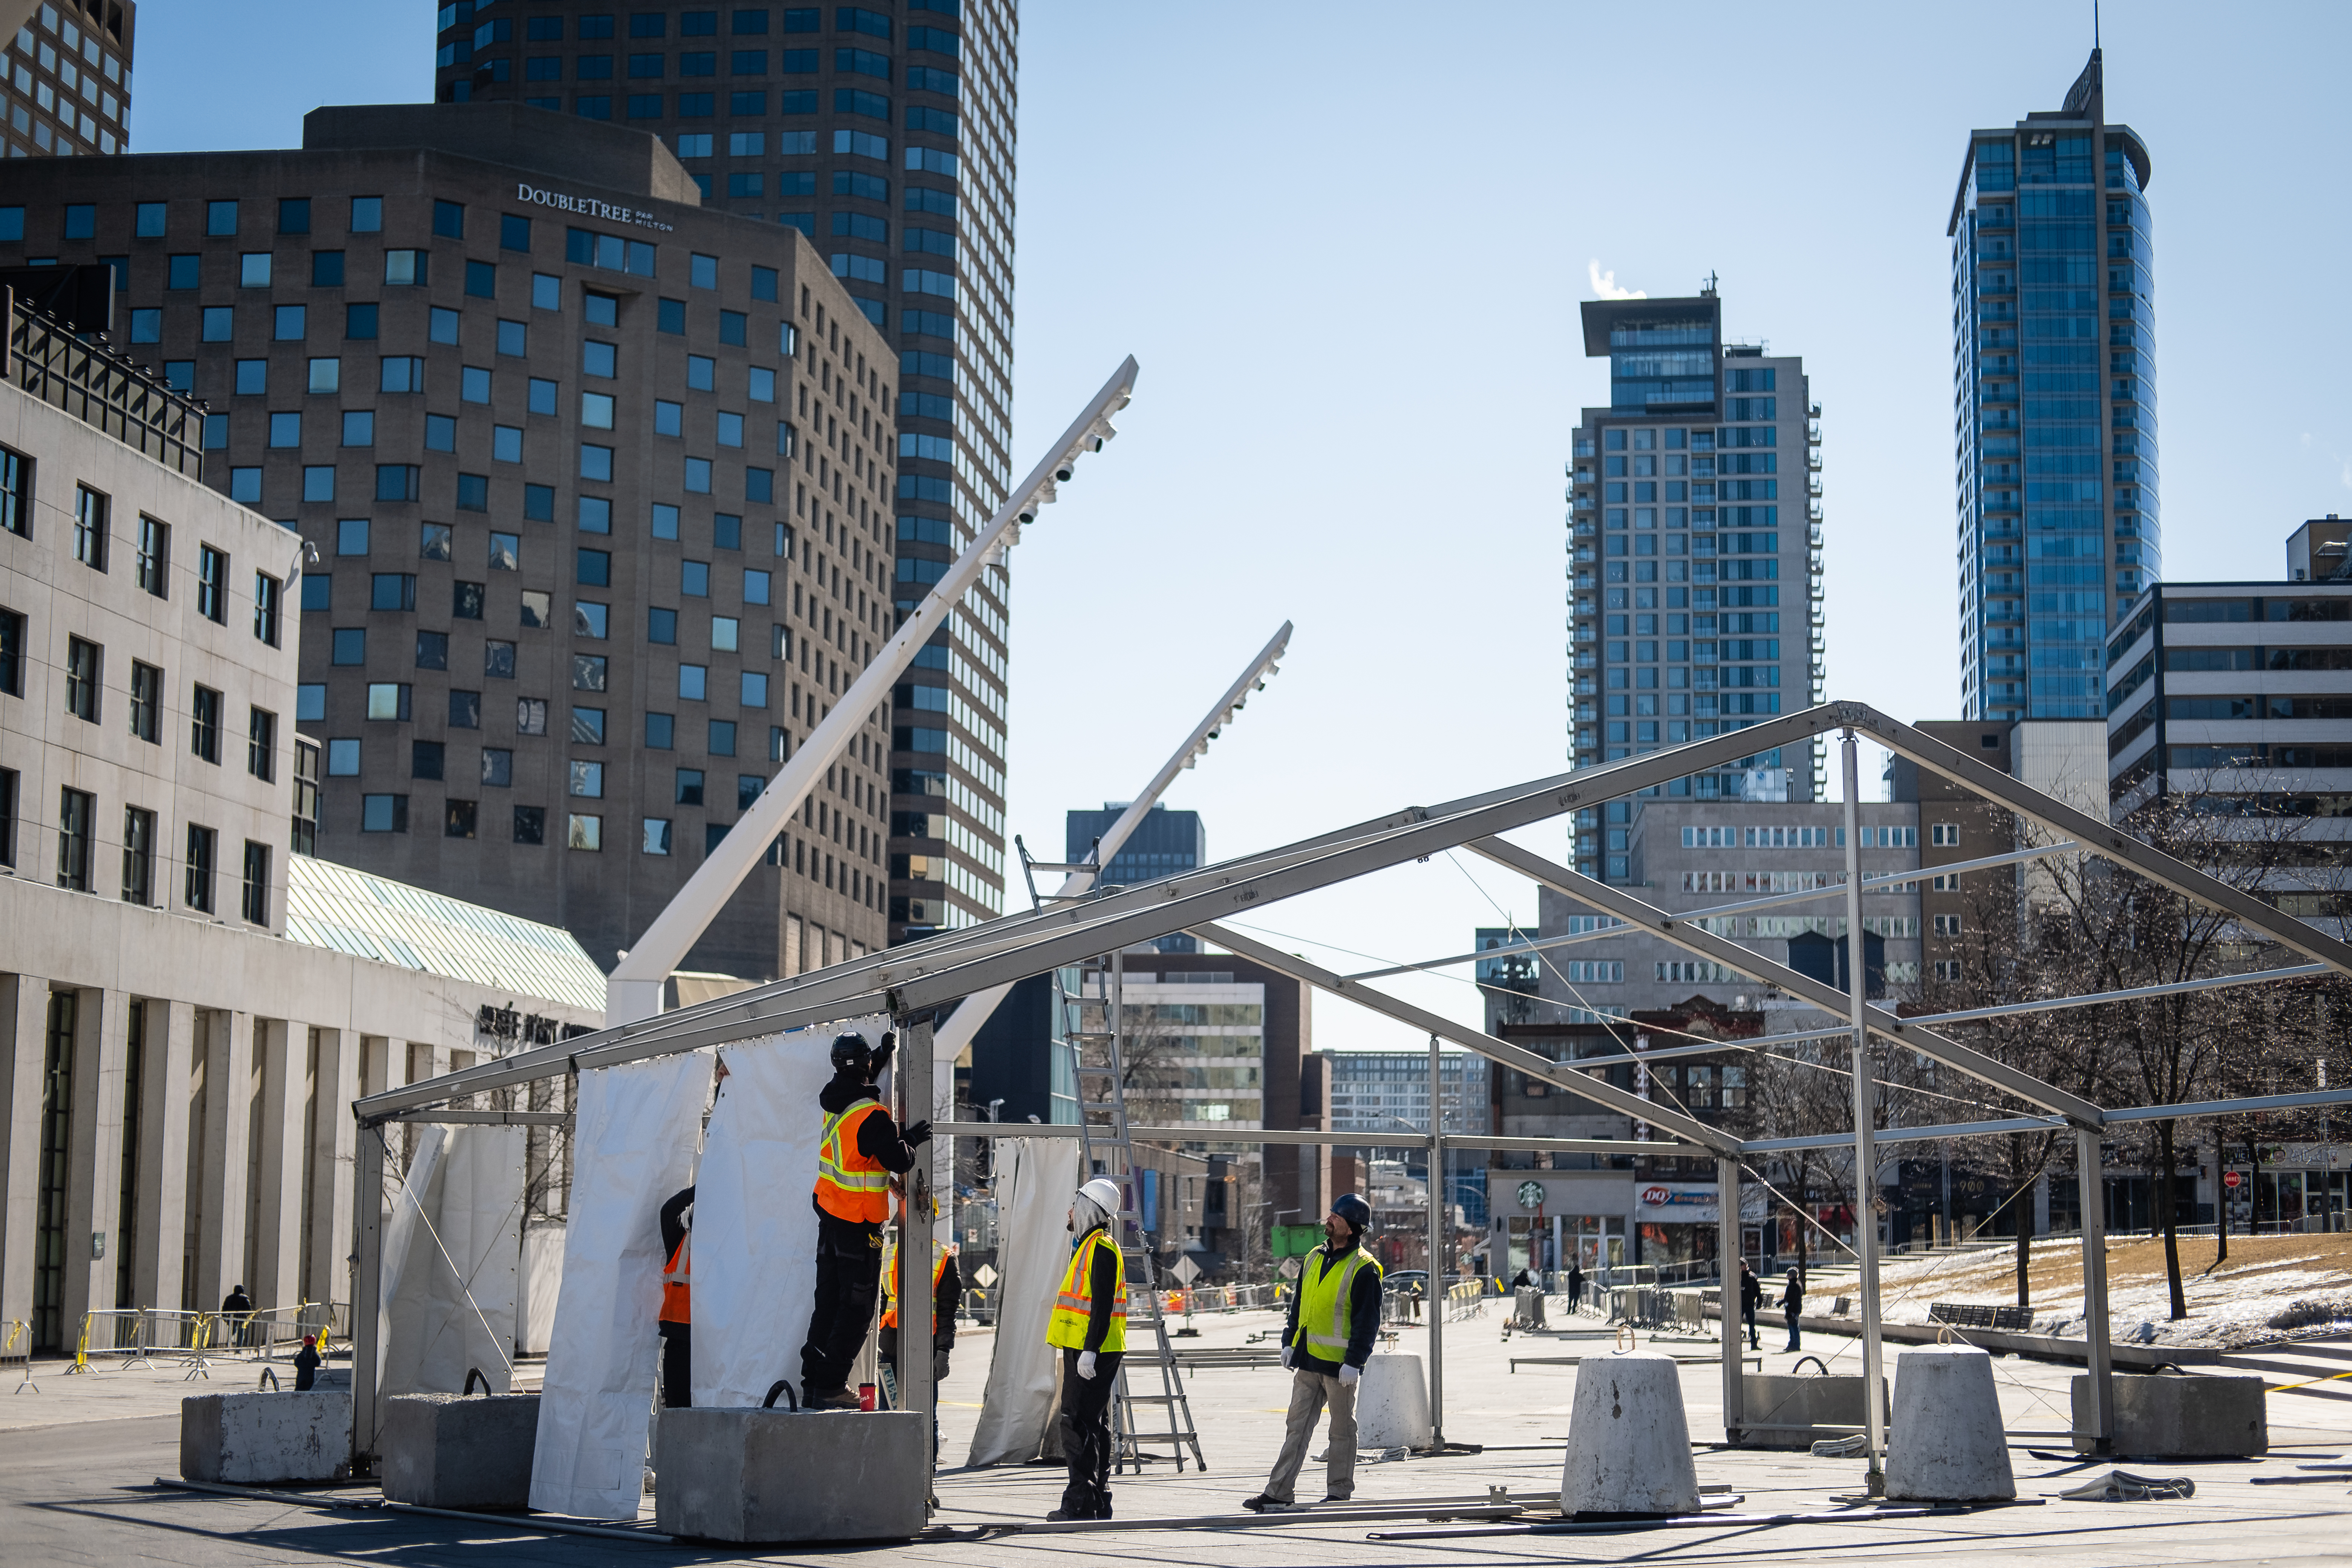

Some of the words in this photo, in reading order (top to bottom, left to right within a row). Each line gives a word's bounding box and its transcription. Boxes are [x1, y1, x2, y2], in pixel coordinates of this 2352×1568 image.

[635, 219, 673, 232] HILTON
[1960, 1180, 1984, 1192] 900
[1646, 1190, 1666, 1201] DQ
